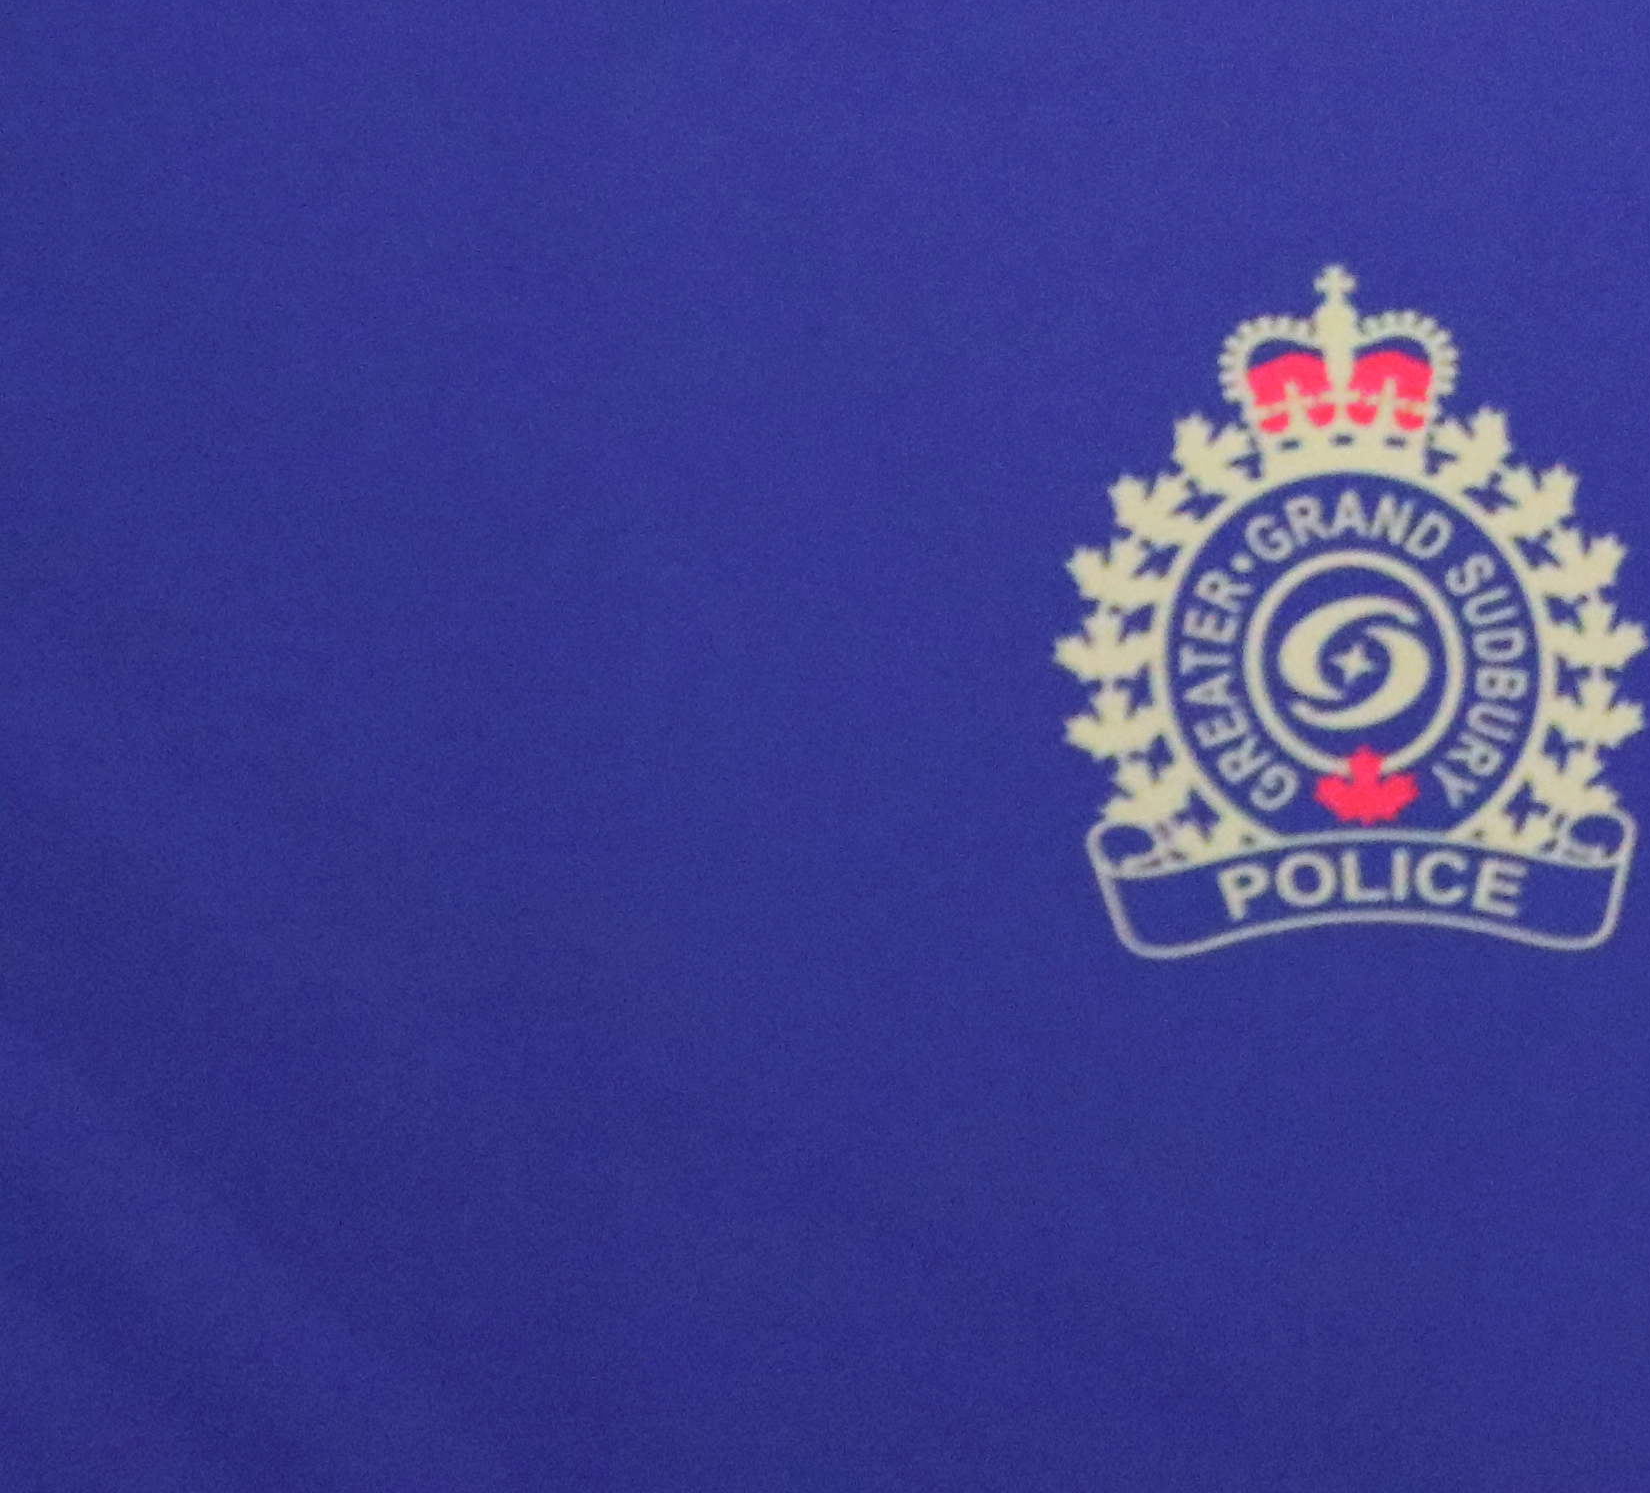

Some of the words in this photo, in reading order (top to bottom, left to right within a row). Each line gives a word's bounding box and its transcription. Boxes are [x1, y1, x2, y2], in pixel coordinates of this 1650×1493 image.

[1179, 569, 1298, 811] GREATER
[1244, 489, 1454, 562] GRAND
[1432, 553, 1528, 808] SUDBURY
[1217, 849, 1528, 920] POLICE
